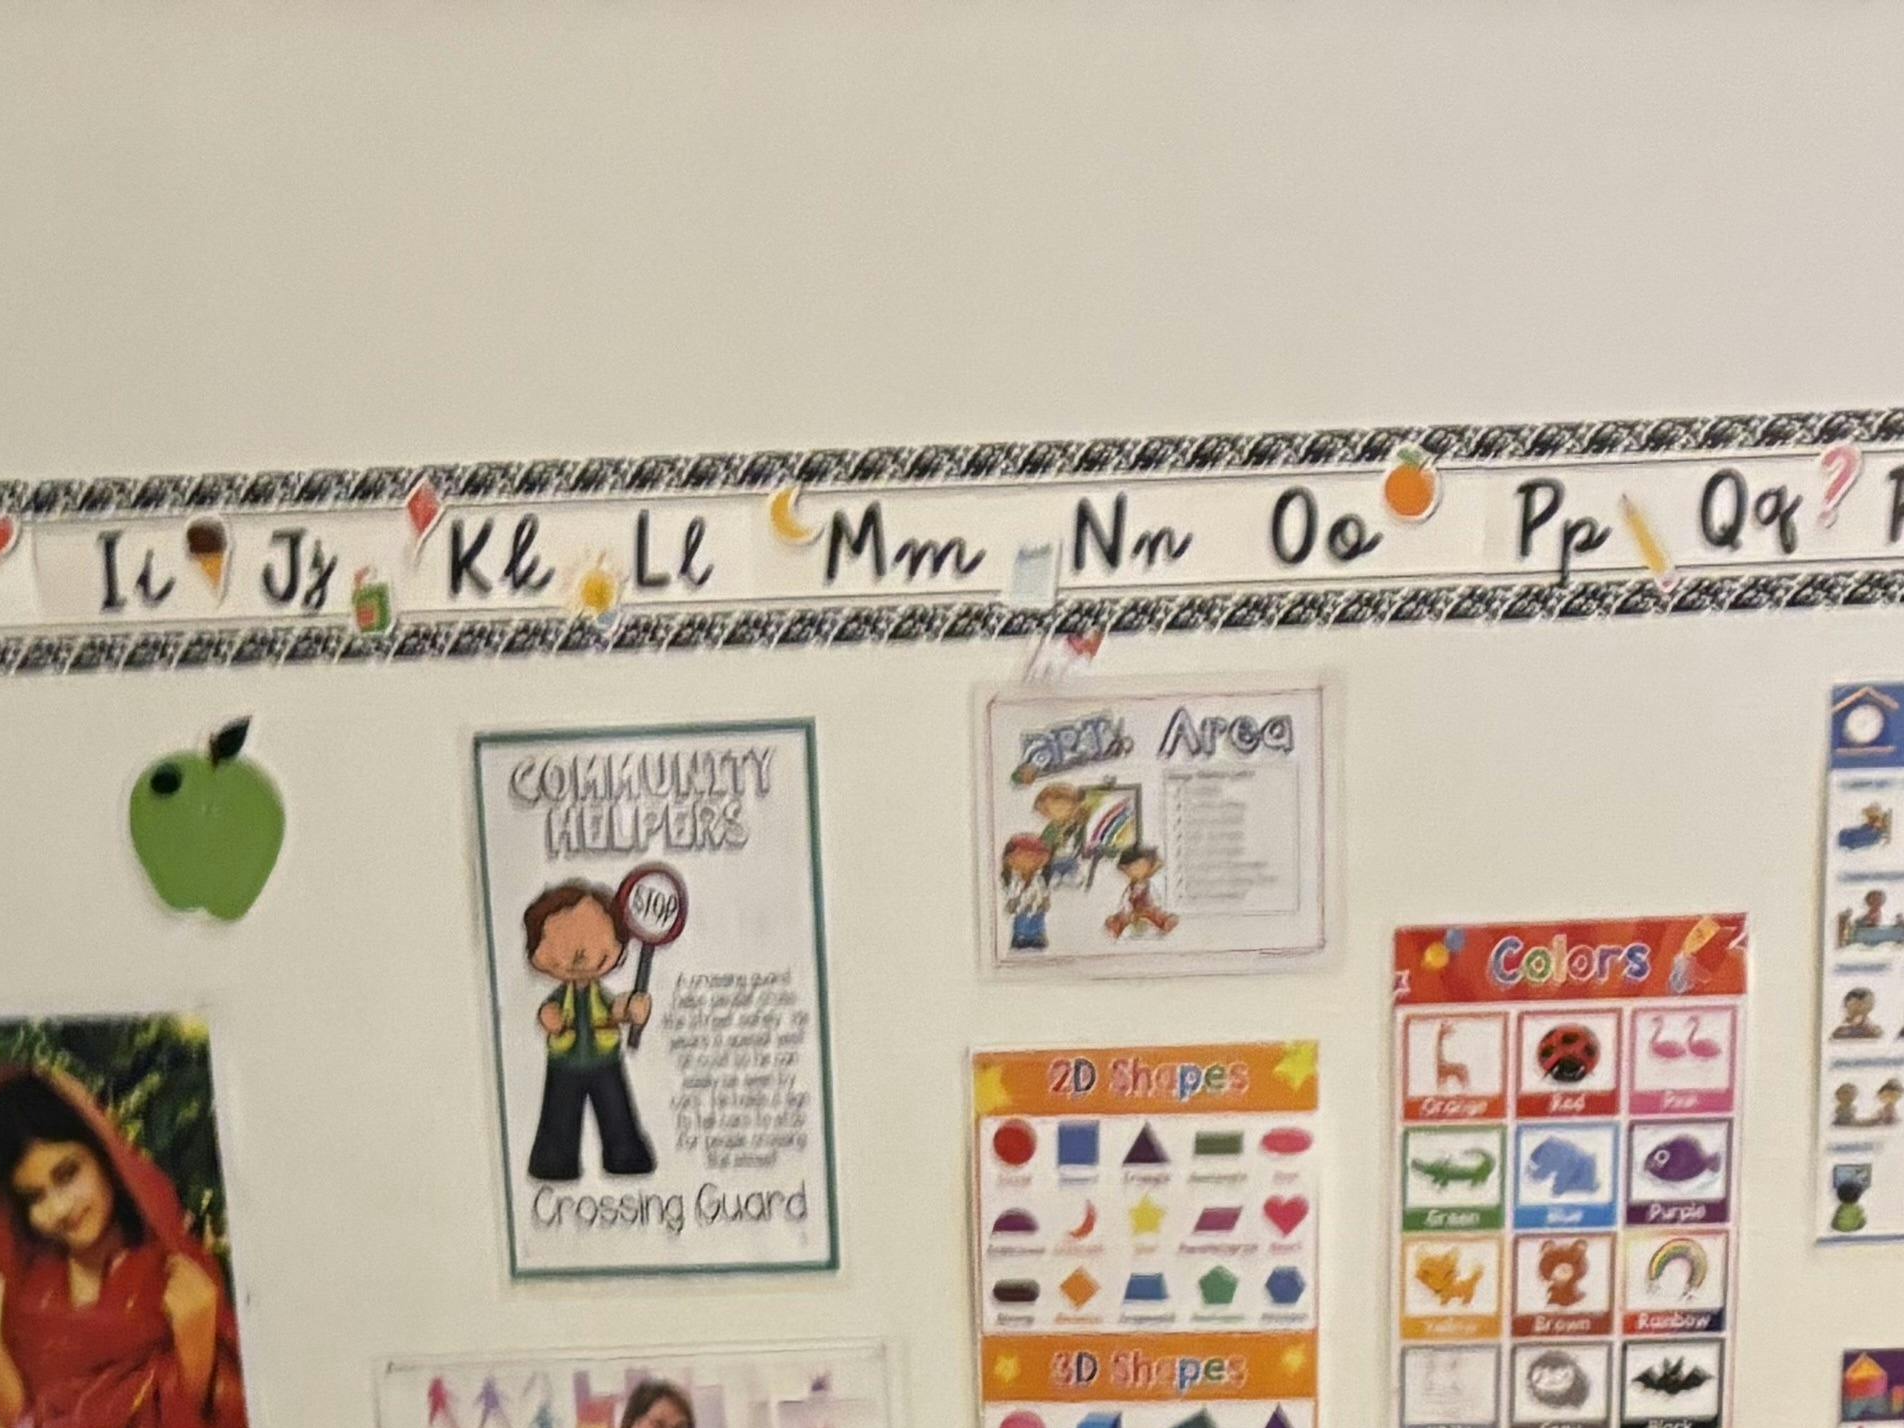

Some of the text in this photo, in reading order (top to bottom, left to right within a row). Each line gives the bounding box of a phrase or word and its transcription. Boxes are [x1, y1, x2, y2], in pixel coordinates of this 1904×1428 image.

[99, 530, 176, 611] Ii
[451, 517, 555, 596] Kk
[637, 508, 715, 586] Ll
[826, 501, 985, 580] Mm
[1074, 492, 1193, 570] Nn
[1272, 488, 1382, 563] Oo
[1516, 477, 1612, 583] Pp
[1701, 469, 1802, 552] Qq
[1158, 706, 1294, 759] Area
[510, 747, 776, 804] COMMUNITY
[547, 800, 748, 857] HELPERS
[632, 885, 678, 927] STOP
[1489, 934, 1652, 988] Colors
[1048, 1057, 1248, 1102] 2D Shapes
[533, 1179, 806, 1235] Crossing Guard
[1424, 1210, 1480, 1228] Green
[1648, 1203, 1706, 1222] Purple
[1535, 1317, 1591, 1333] Brown
[1051, 1350, 1245, 1395] 3D Shapes
